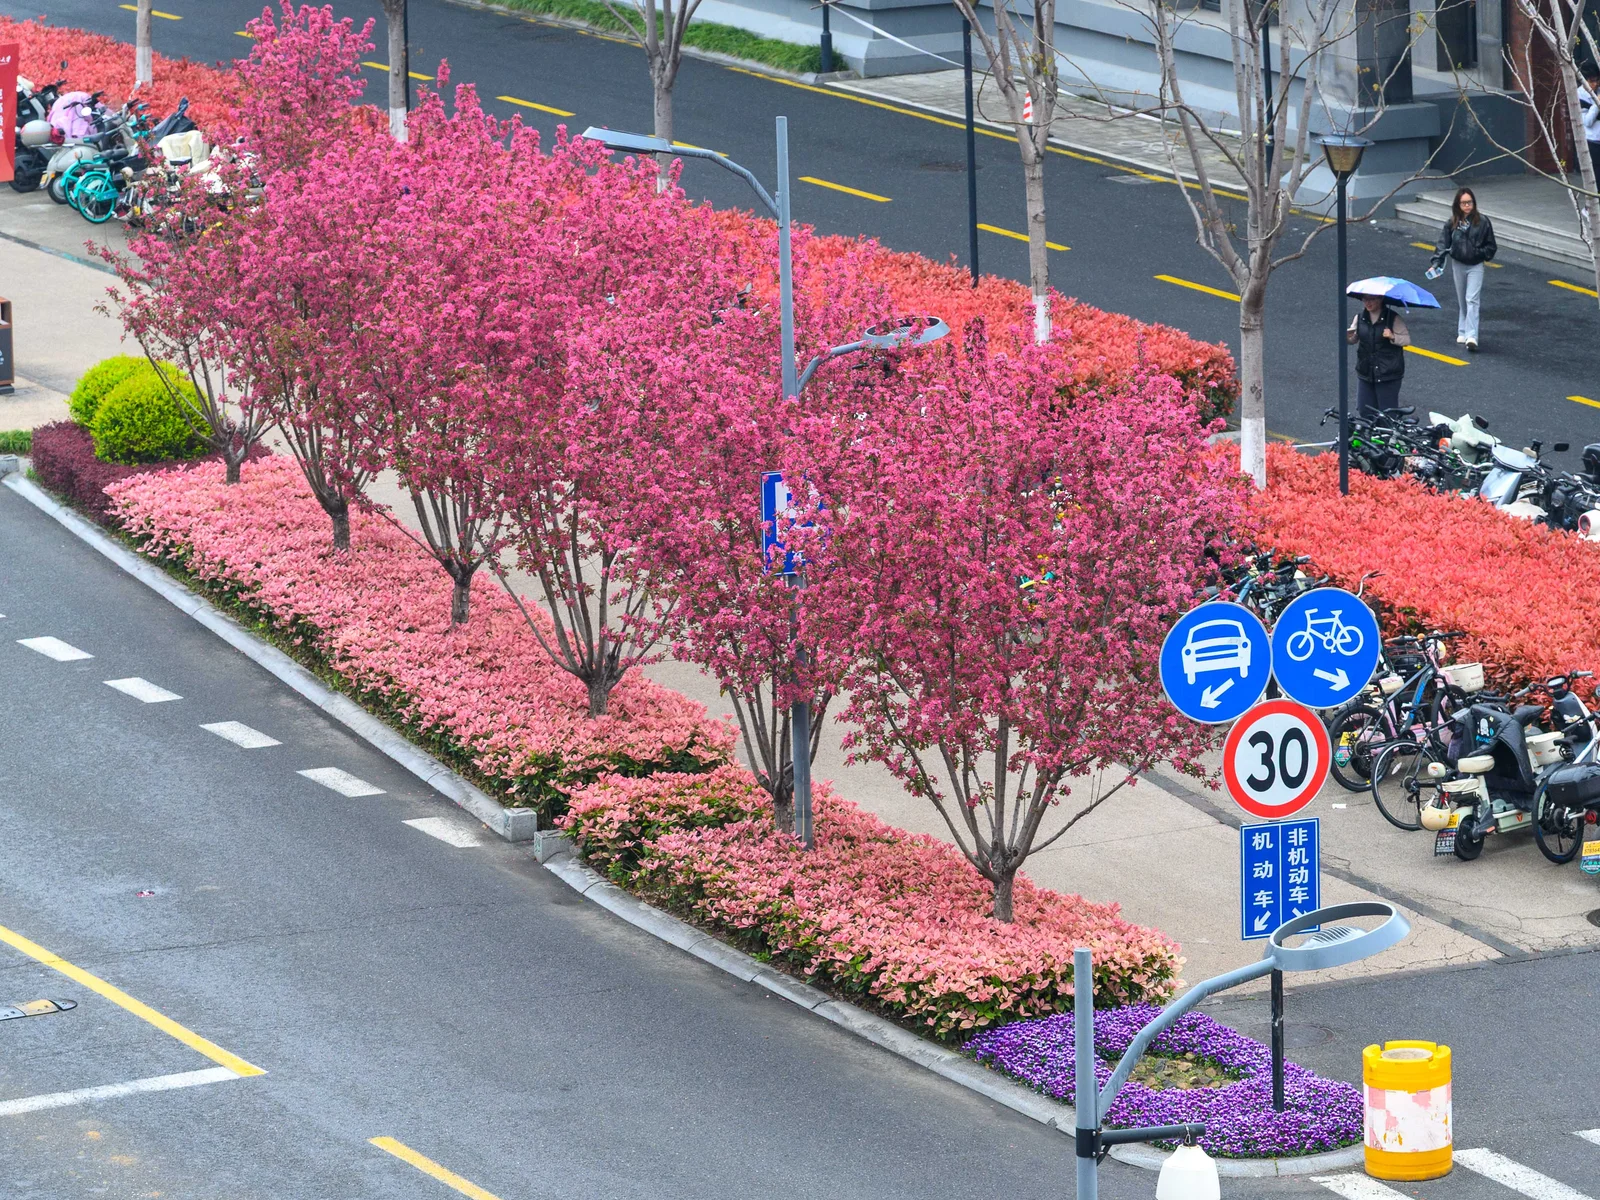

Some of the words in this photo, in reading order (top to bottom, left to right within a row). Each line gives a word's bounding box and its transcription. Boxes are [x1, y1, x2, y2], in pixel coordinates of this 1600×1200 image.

[1246, 727, 1308, 792] 30
[1252, 832, 1273, 908] 机动车
[1288, 828, 1309, 904] 非机动车
